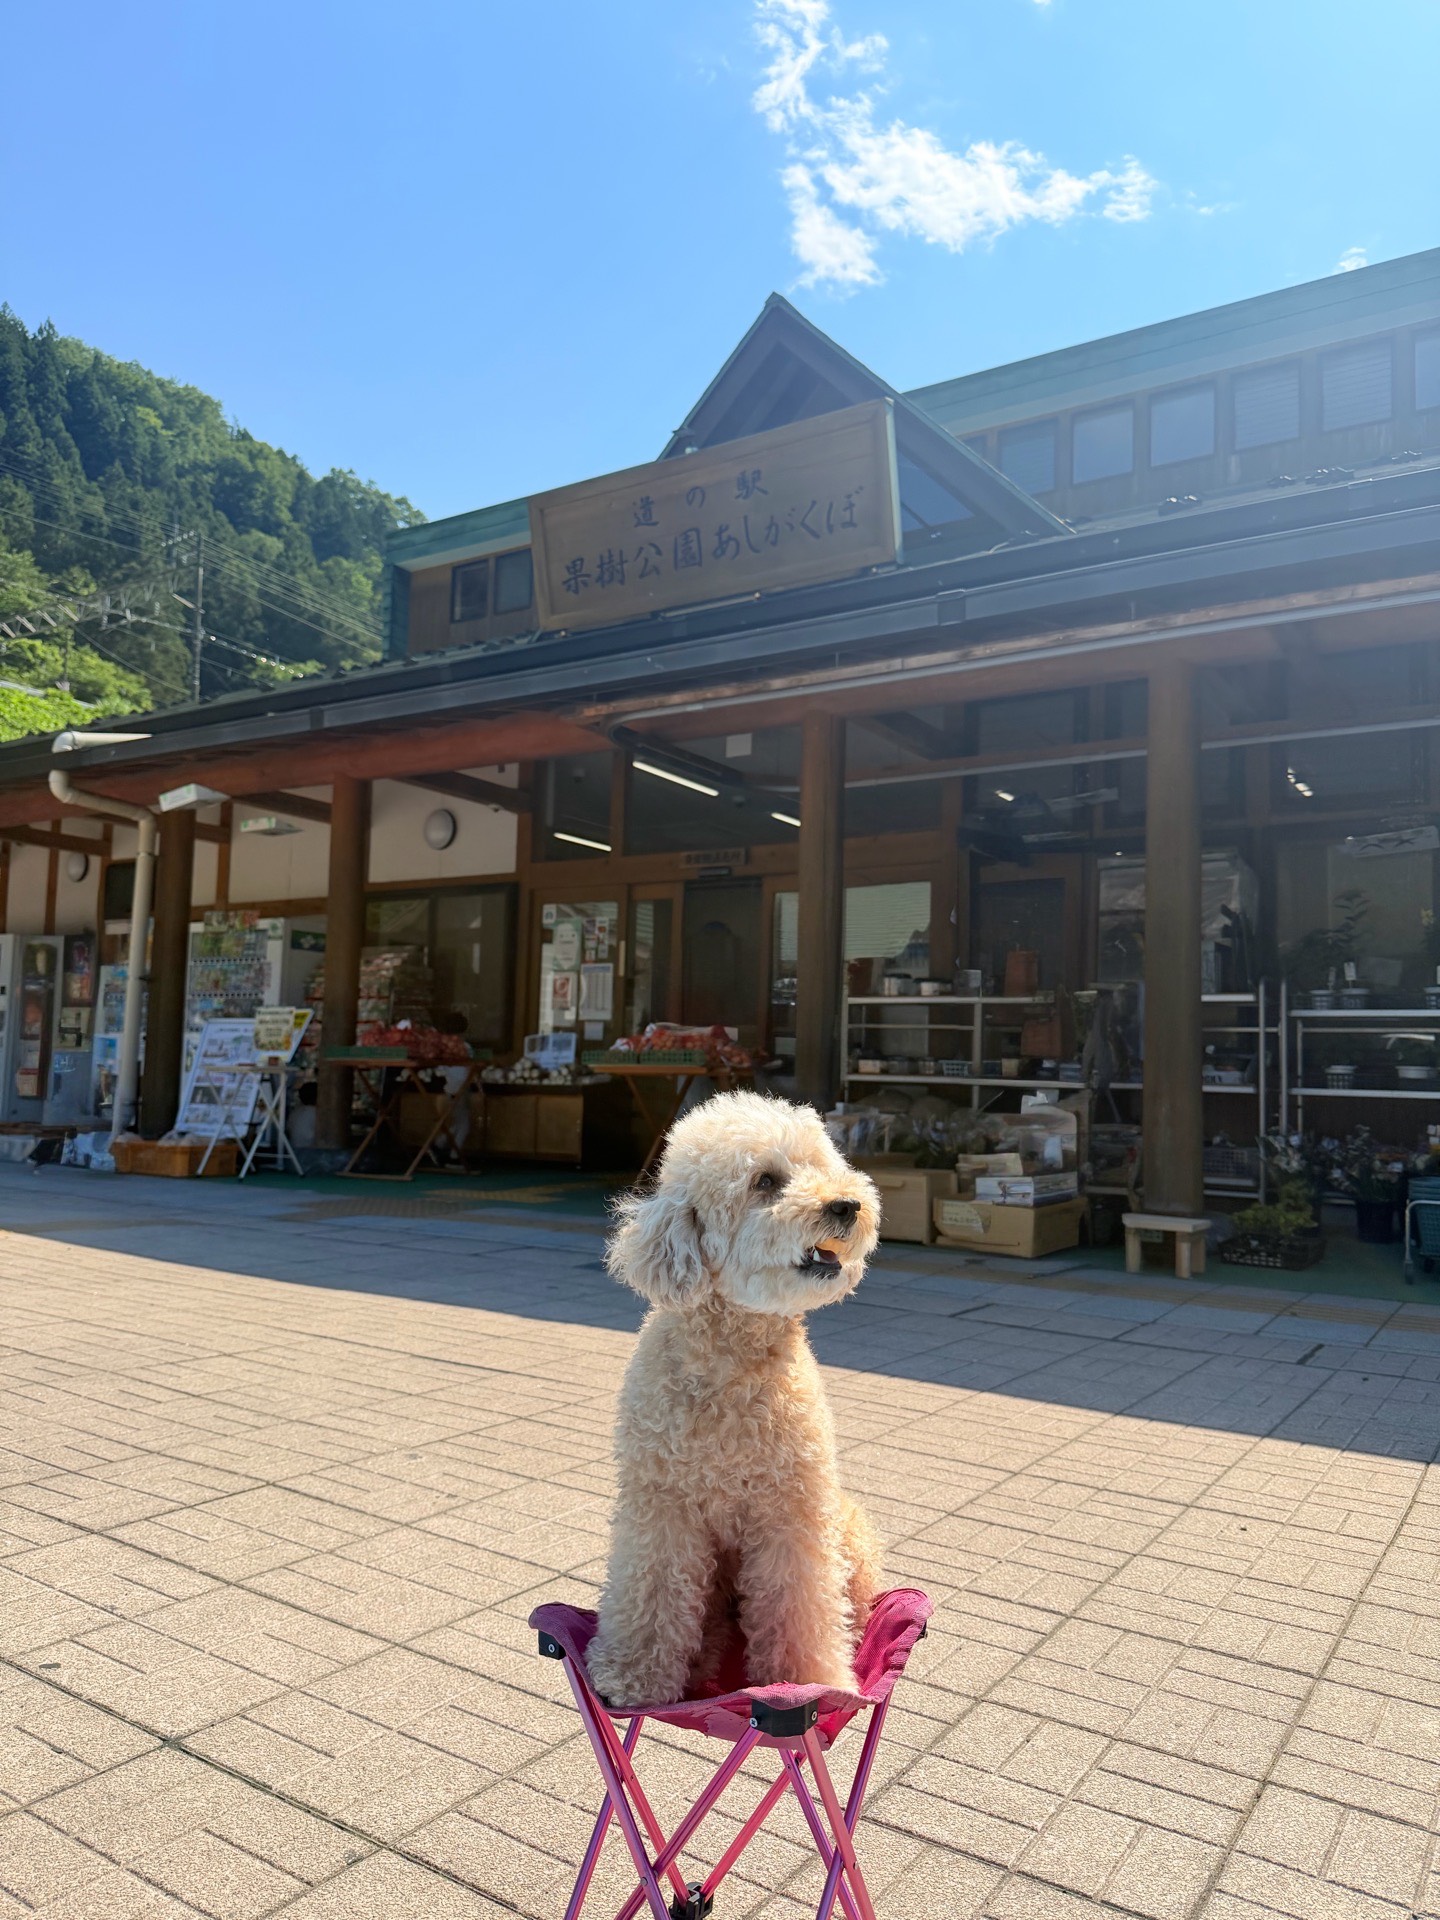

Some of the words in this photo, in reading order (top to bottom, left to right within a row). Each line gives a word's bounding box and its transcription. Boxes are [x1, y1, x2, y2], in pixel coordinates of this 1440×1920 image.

[561, 485, 865, 595] 果樹公園あしがくぼ
[632, 468, 769, 528] 道の駅
